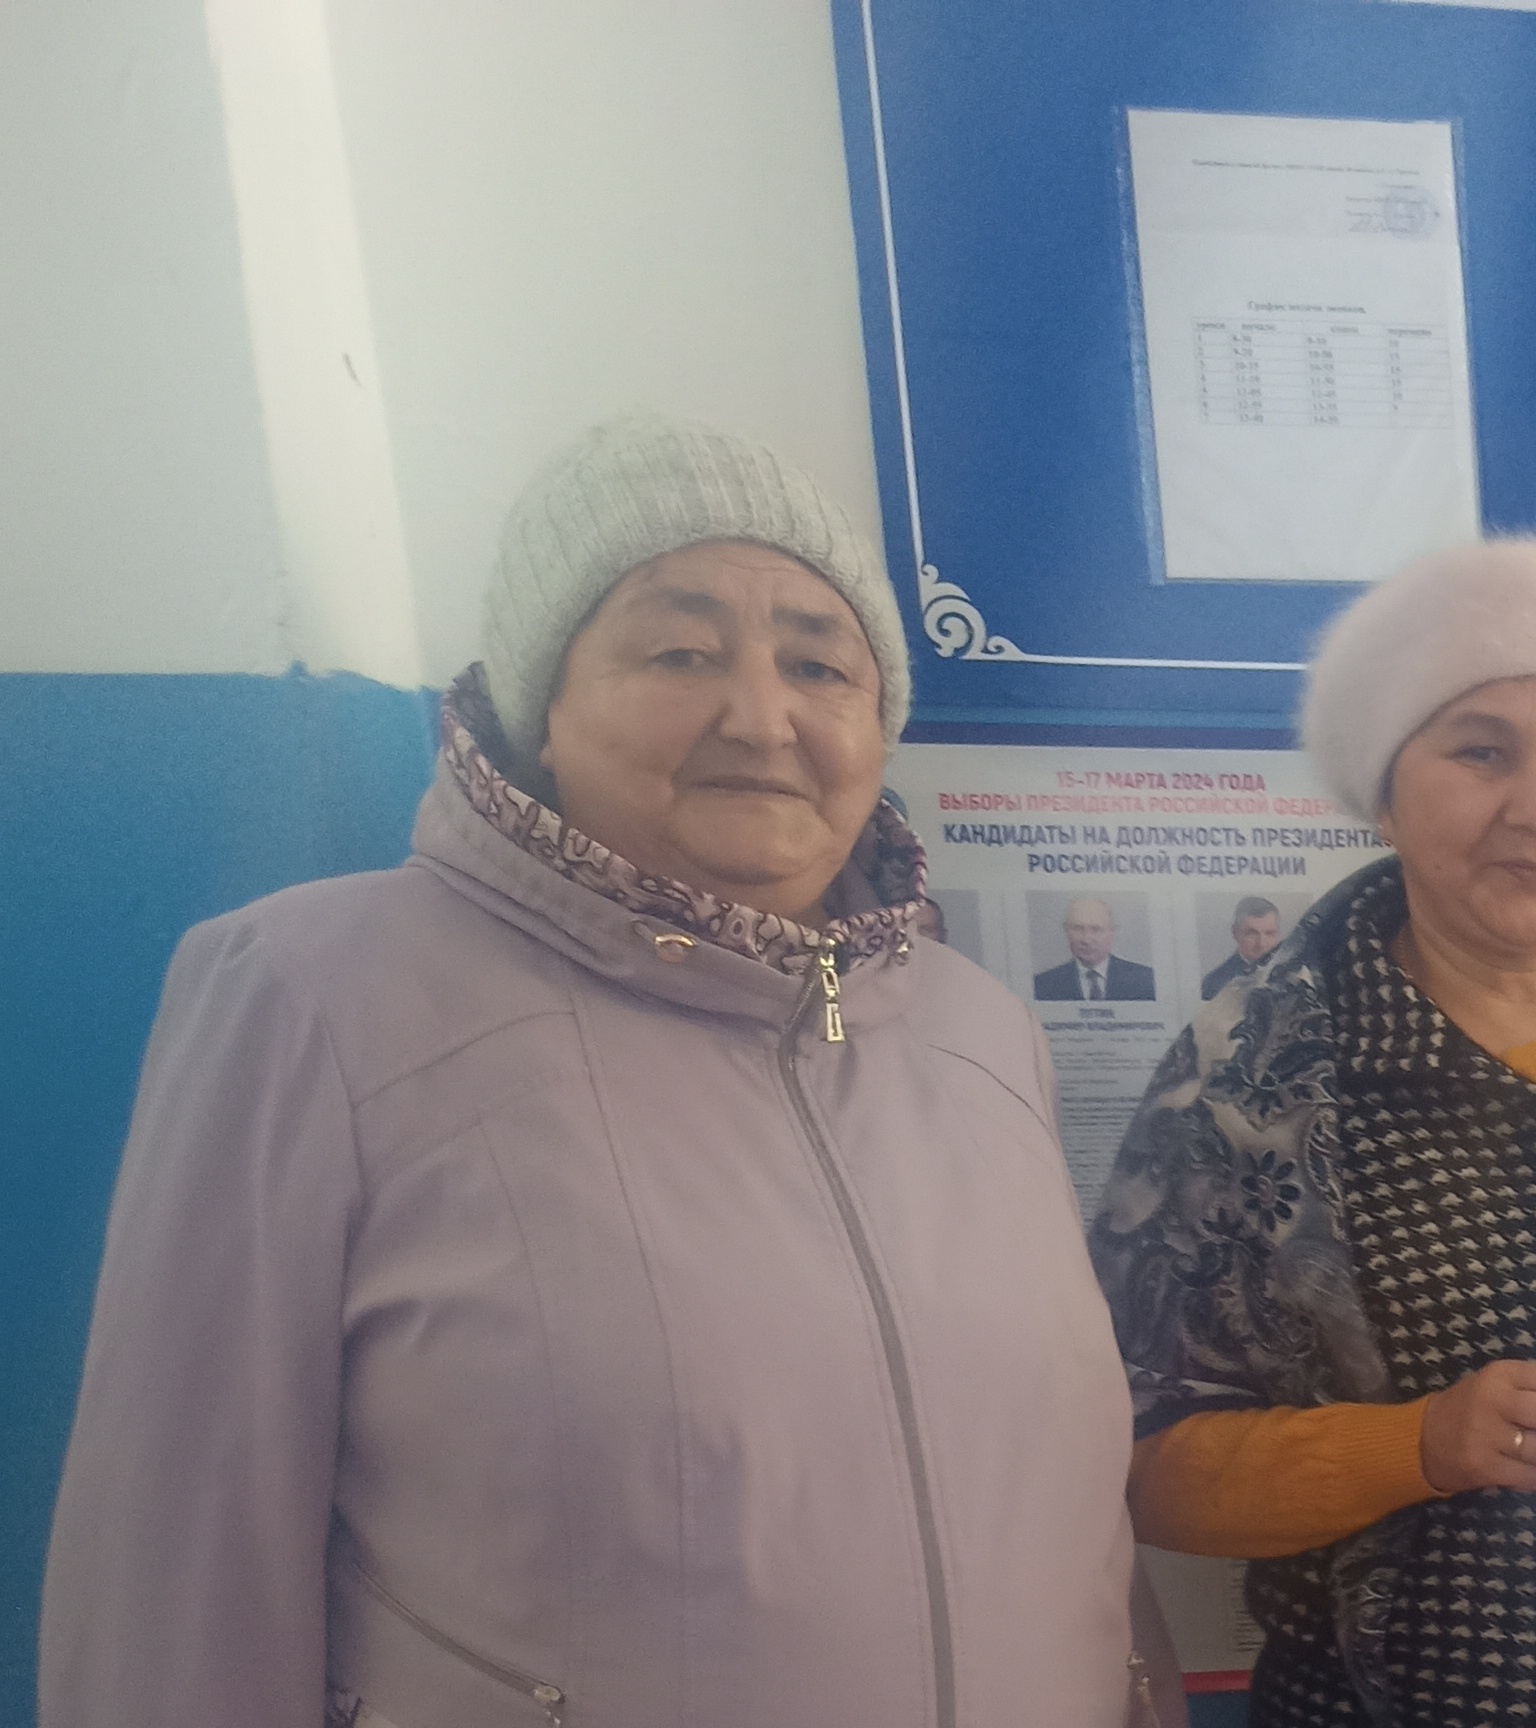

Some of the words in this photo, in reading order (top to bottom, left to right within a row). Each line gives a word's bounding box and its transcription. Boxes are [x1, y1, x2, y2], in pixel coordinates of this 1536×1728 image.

[1105, 772, 1168, 791] МАРТА
[1172, 773, 1215, 791] 2024
[1219, 773, 1266, 792] ГОДА
[939, 793, 1023, 811] ВЫБОРЫ
[1026, 794, 1145, 815] ПРЕЗИДЕНТА
[1148, 791, 1270, 816] РОССИЙСКОЙ
[944, 823, 1078, 848] КАНДИДАТЫ
[1083, 826, 1110, 846] НА
[1117, 826, 1247, 849] ДОЛЖНОСТЬ
[1252, 828, 1383, 851] ПРЕЗИДЕНТА
[1028, 850, 1172, 875] РОССИЙСКОЙ
[1177, 855, 1307, 878] ФЕДЕРАЦИИ
